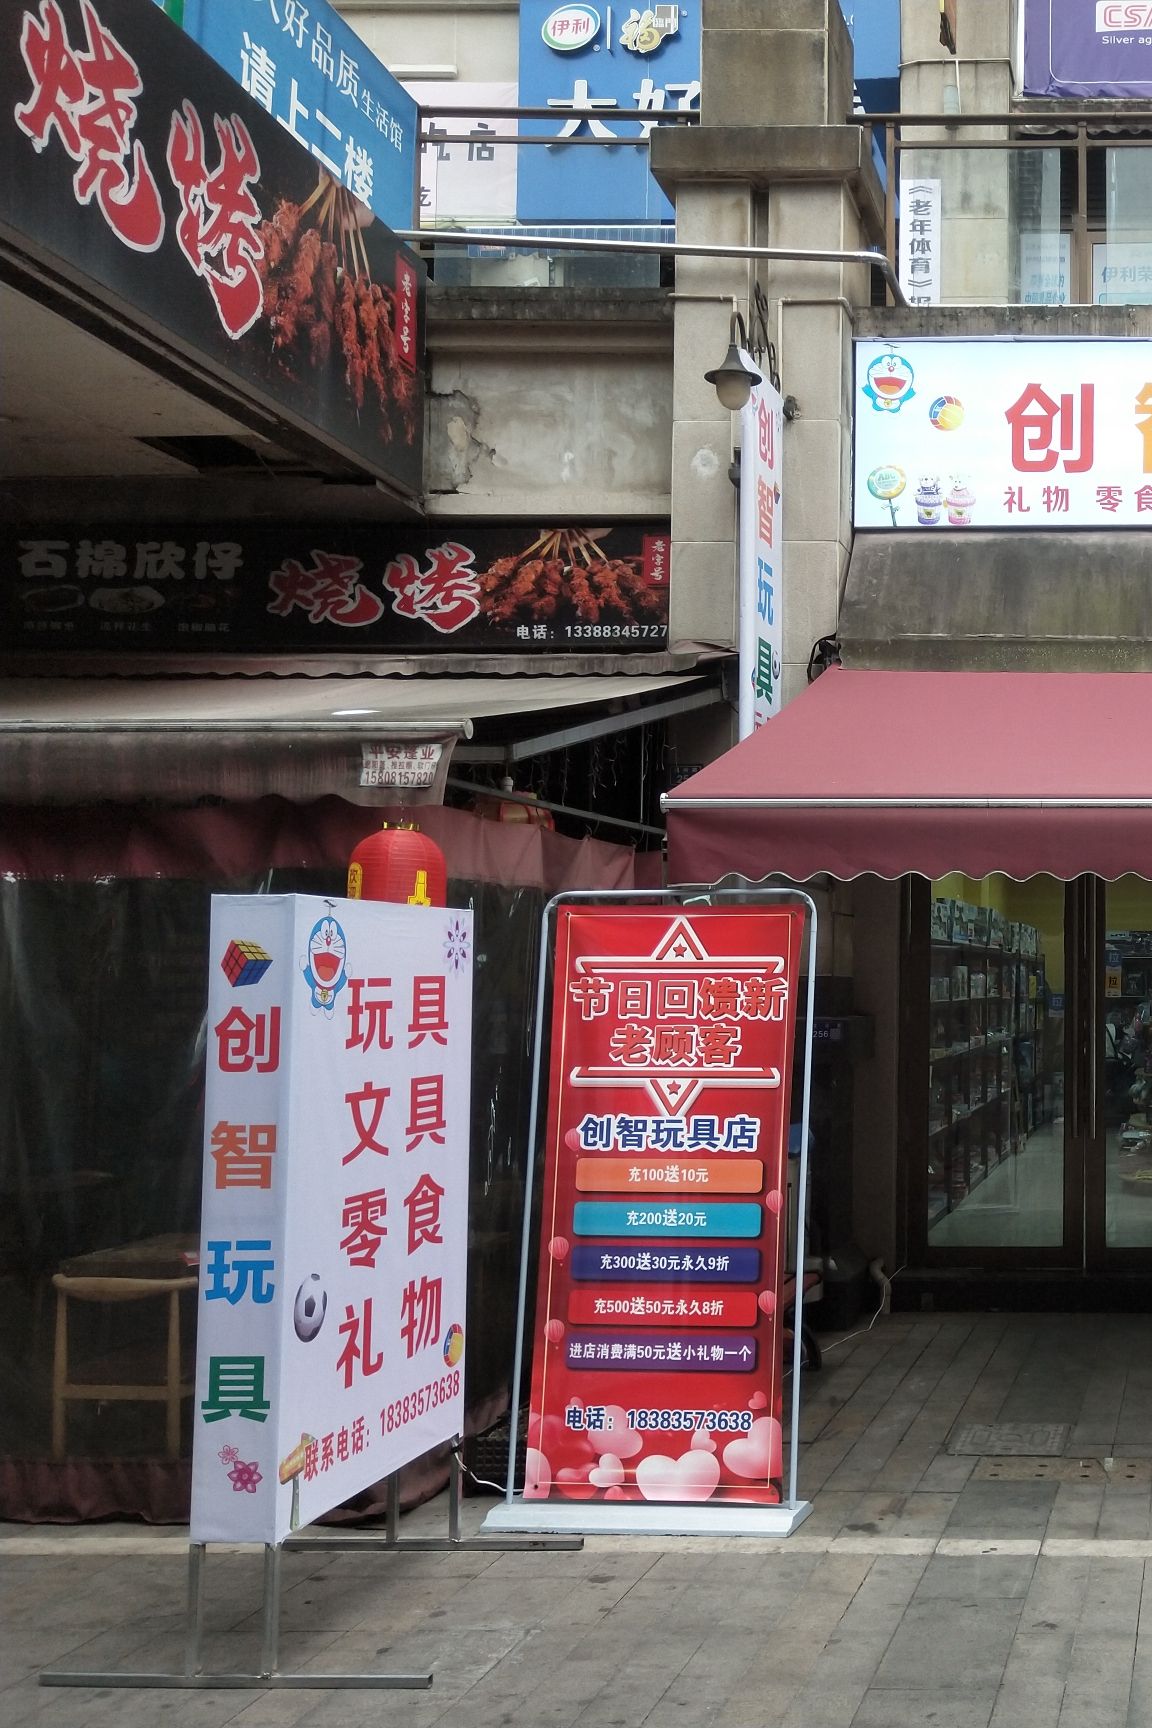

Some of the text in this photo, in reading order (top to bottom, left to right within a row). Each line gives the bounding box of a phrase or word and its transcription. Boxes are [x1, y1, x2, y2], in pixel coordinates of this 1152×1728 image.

[551, 17, 590, 37] 伊利
[1101, 35, 1134, 44] Silver
[270, 0, 403, 153] 好品质生活馆
[240, 31, 374, 210] 请上二楼
[15, 0, 265, 340] 烧烤
[1003, 485, 1070, 514] 礼物
[17, 538, 244, 581] 石棉欣仔
[650, 539, 667, 581] 老字号
[756, 399, 775, 706] 创智玩具
[268, 541, 482, 634] 烧烤
[565, 624, 668, 638] 13388345727
[365, 771, 433, 785] 15808157820
[345, 975, 449, 1053] 玩具
[569, 976, 789, 1022] 节日回馈新
[609, 1024, 743, 1068] 老顾客
[342, 1073, 447, 1167] 文具
[578, 1114, 761, 1152] 创智玩具店
[628, 1165, 709, 1183] 充100送10元
[200, 1005, 282, 1424] 创智玩具
[340, 1173, 445, 1269] 零食
[626, 1209, 707, 1227] 充200送20元
[600, 1252, 730, 1271] 充300送30元永久9折
[594, 1296, 724, 1316] 充500送50元永久8折
[336, 1276, 443, 1389] 礼物
[568, 1341, 752, 1362] 进店消费满50元送小礼物一个
[379, 1370, 461, 1437] 18383573638
[626, 1409, 752, 1432] 18383573638
